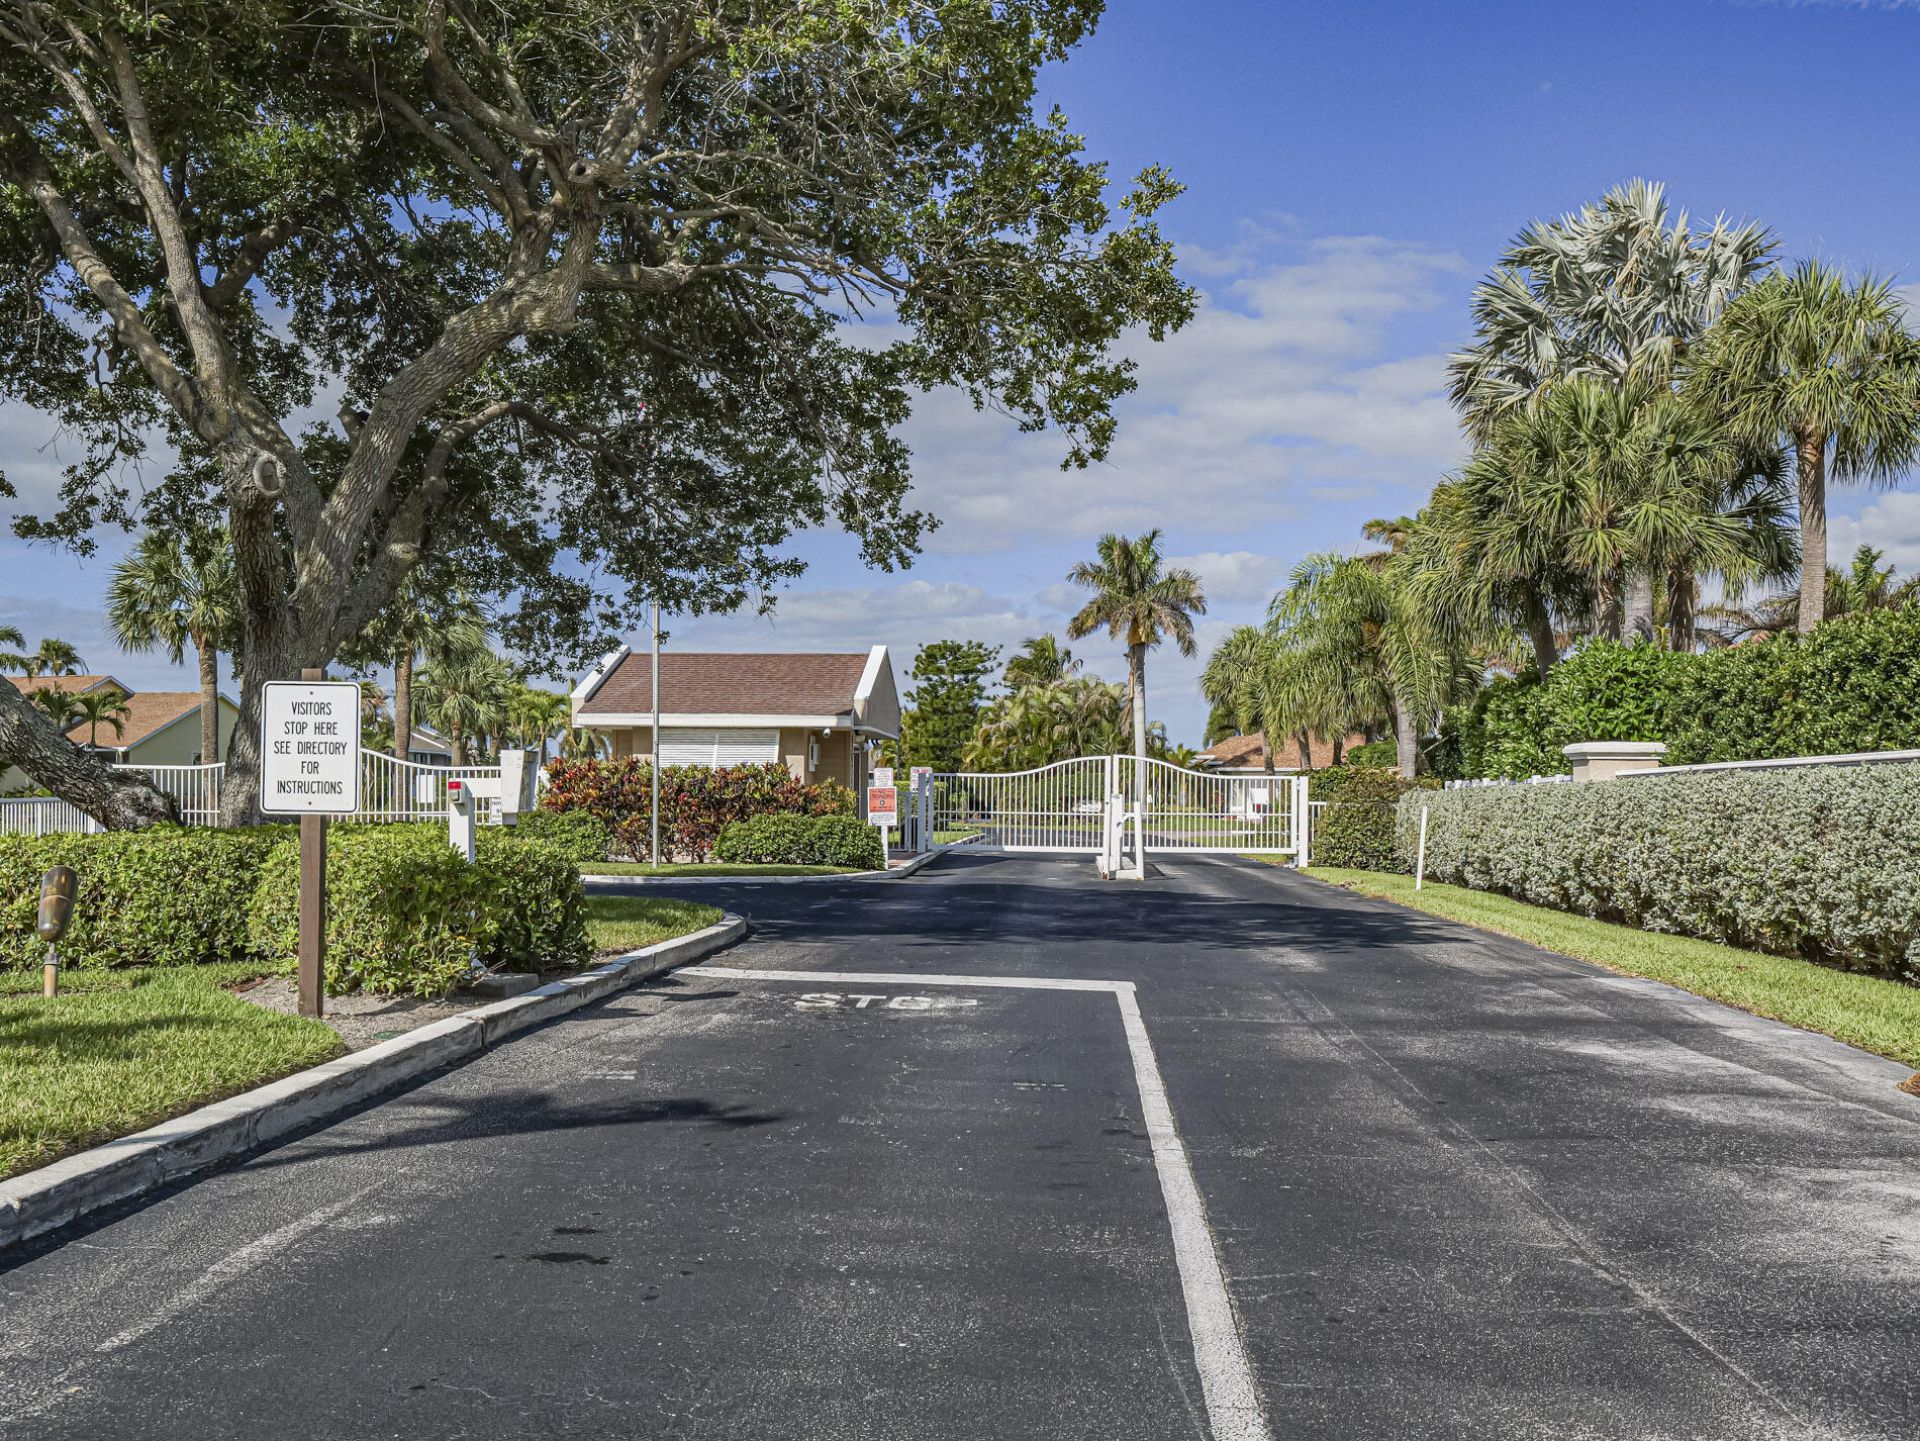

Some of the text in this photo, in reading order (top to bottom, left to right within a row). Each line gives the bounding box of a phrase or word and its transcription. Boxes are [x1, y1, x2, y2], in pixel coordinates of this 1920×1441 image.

[291, 702, 332, 716] VISITORS
[284, 721, 338, 735] STOP HERE
[273, 741, 347, 755] SEE DIRECTORY
[301, 761, 320, 775] FOR
[277, 781, 343, 795] INSTRUCTIONS
